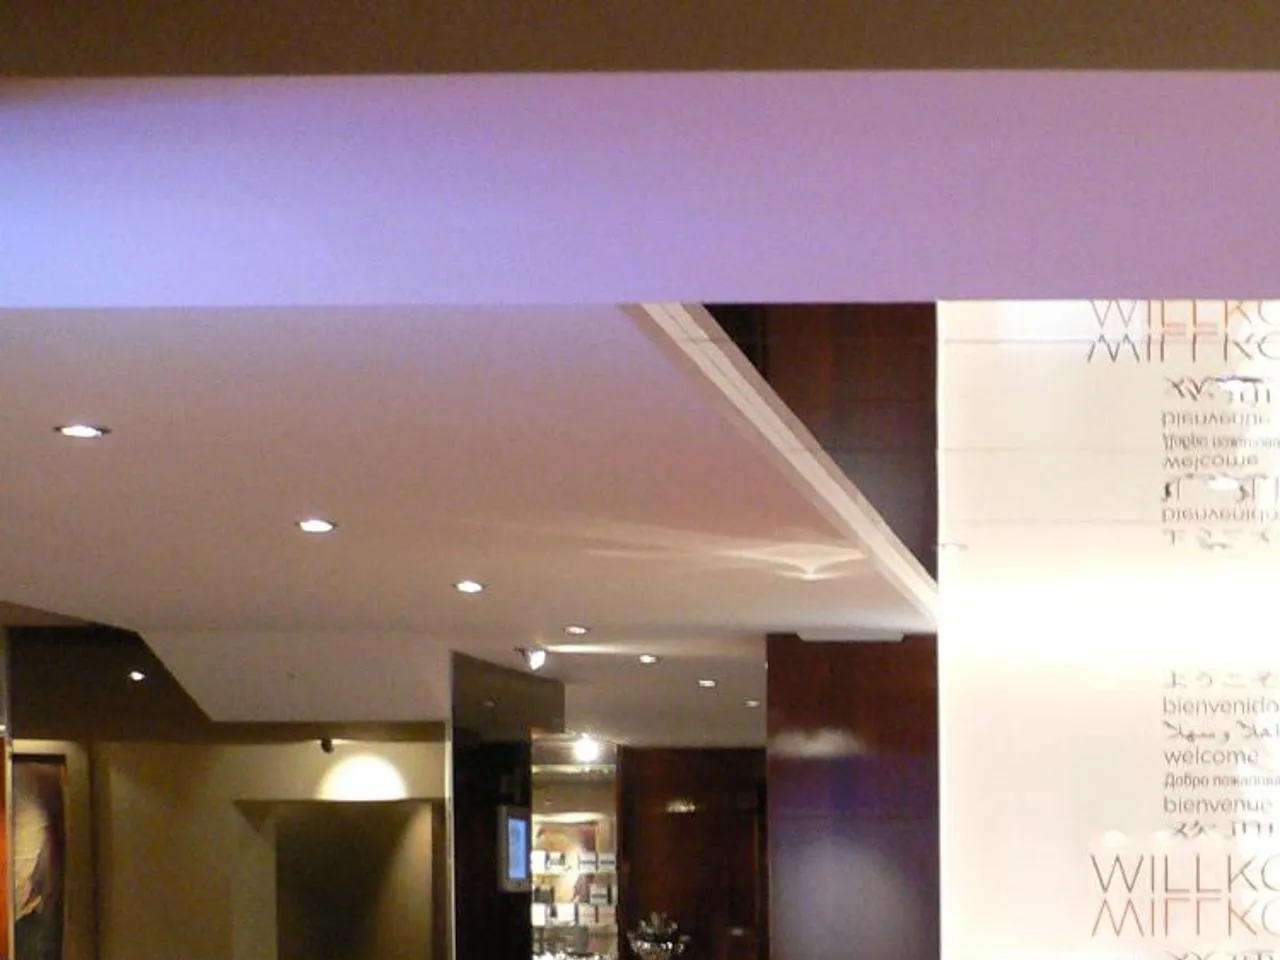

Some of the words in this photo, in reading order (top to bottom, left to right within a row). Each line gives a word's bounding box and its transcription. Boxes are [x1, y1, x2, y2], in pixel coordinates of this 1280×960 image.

[1163, 745, 1259, 766] welcome
[1164, 772, 1209, 791] Добро
[1163, 795, 1273, 814] bienvenue
